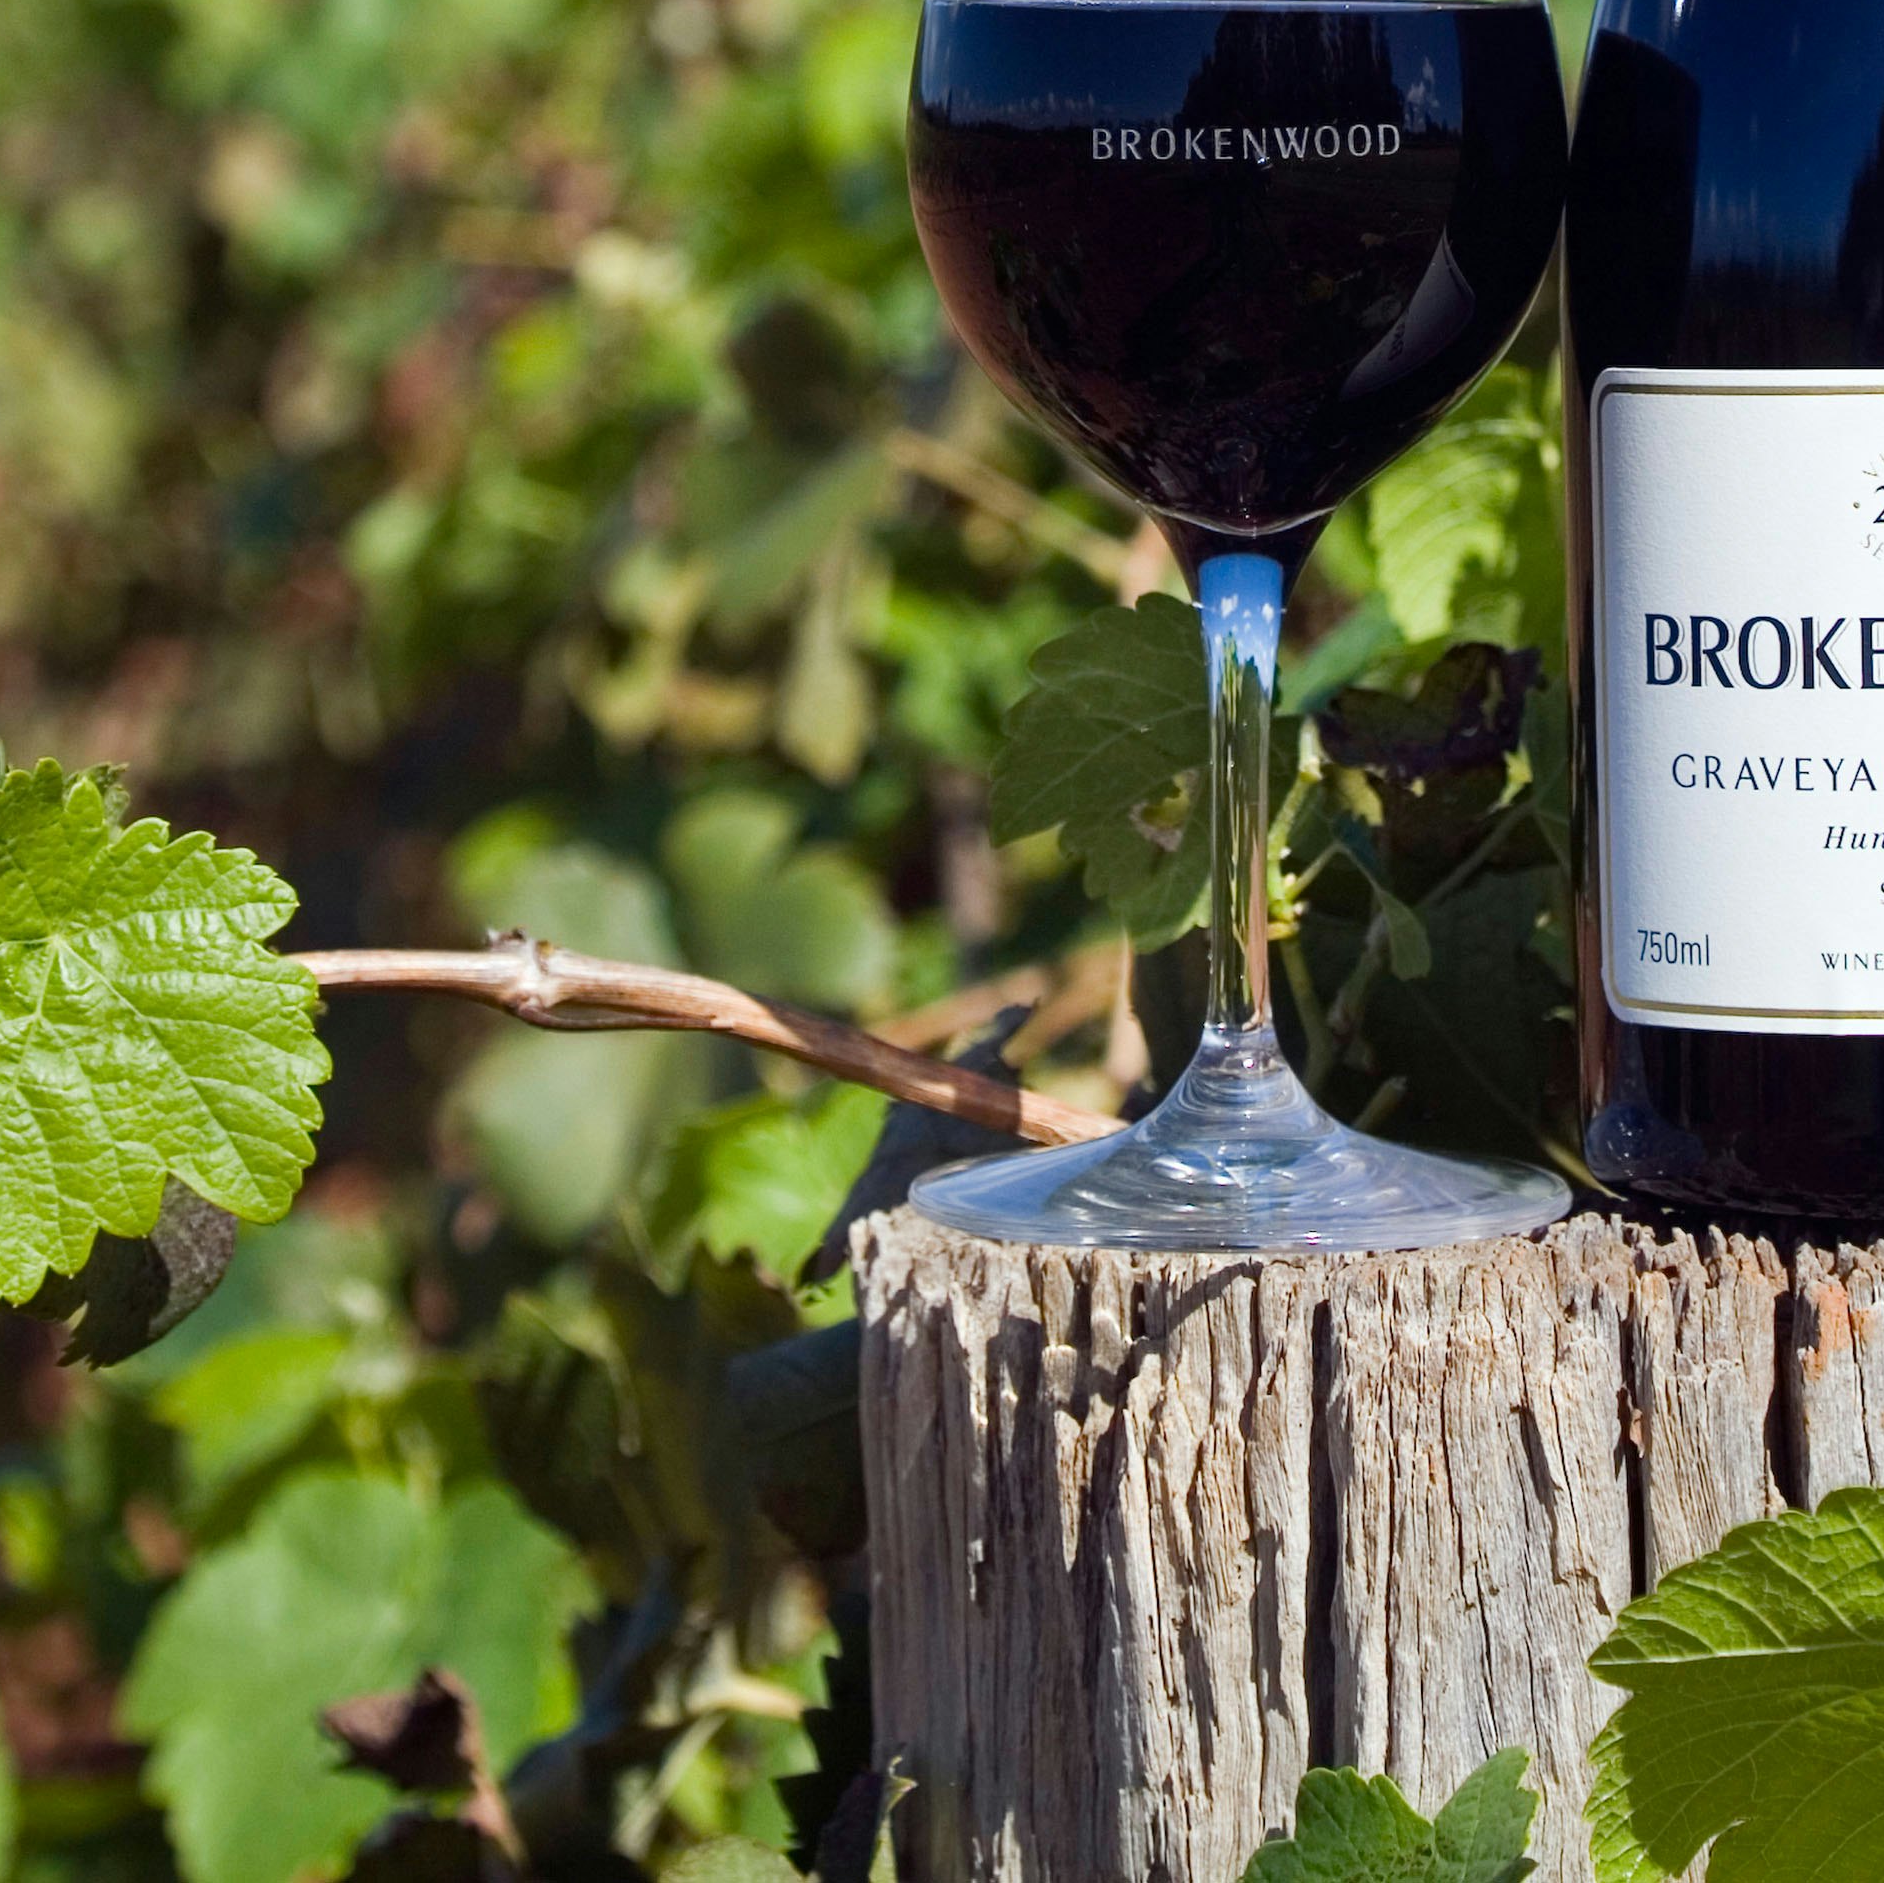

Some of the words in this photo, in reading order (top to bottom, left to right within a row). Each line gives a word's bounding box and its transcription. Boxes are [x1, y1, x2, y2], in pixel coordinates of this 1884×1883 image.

[1091, 123, 1401, 162] BROKENWOOD
[1636, 928, 1711, 967] 750ml
[1820, 952, 1884, 971] WINE
